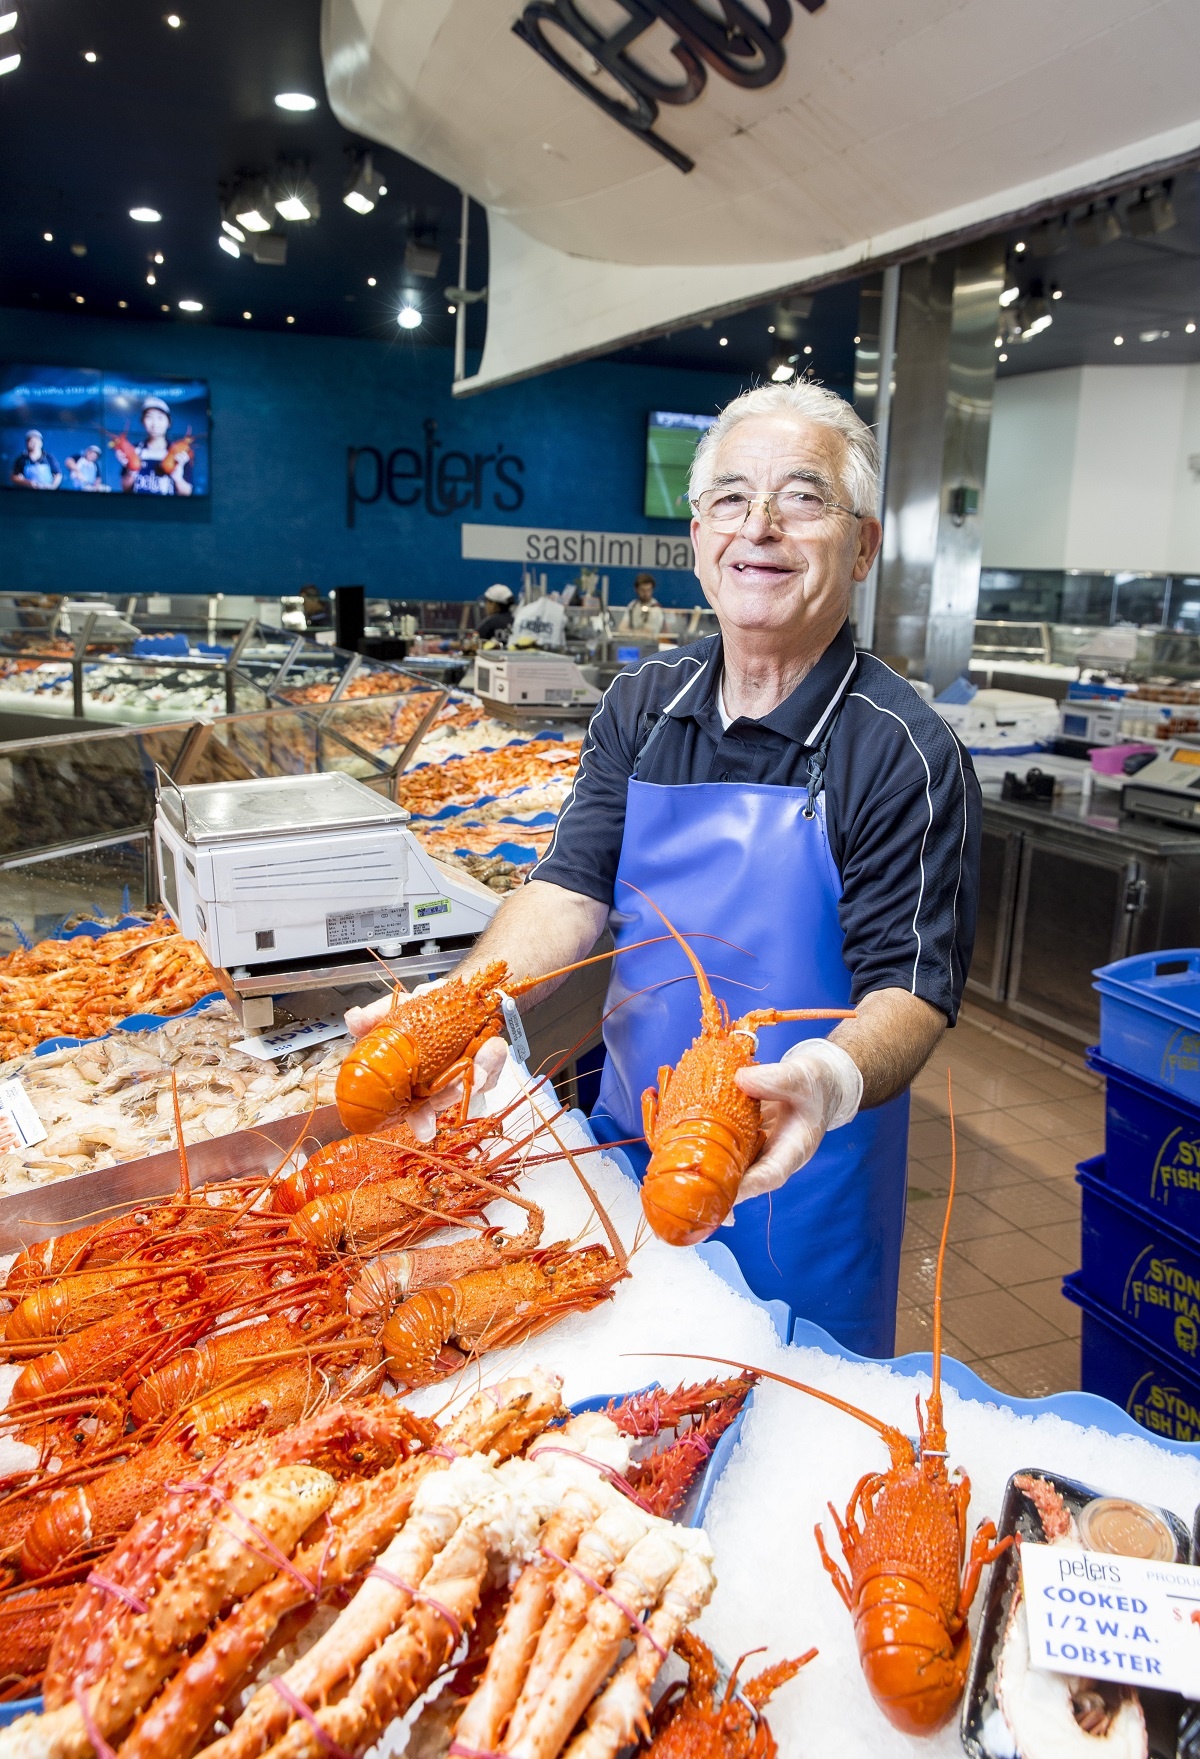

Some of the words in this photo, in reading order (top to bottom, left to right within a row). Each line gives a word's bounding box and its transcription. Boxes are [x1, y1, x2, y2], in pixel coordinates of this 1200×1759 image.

[346, 418, 525, 528] peter's
[526, 533, 642, 565] sashimi
[264, 1021, 330, 1045] EACH
[1160, 1165, 1200, 1191] FISH
[1132, 1281, 1171, 1309] FISH
[1133, 1404, 1173, 1437] FISH
[1059, 1553, 1121, 1584] peter's
[1043, 1585, 1148, 1614] COOKED
[1046, 1612, 1089, 1633] 1/2
[1096, 1619, 1159, 1644] W.A.
[1045, 1640, 1163, 1675] LOBSTER
